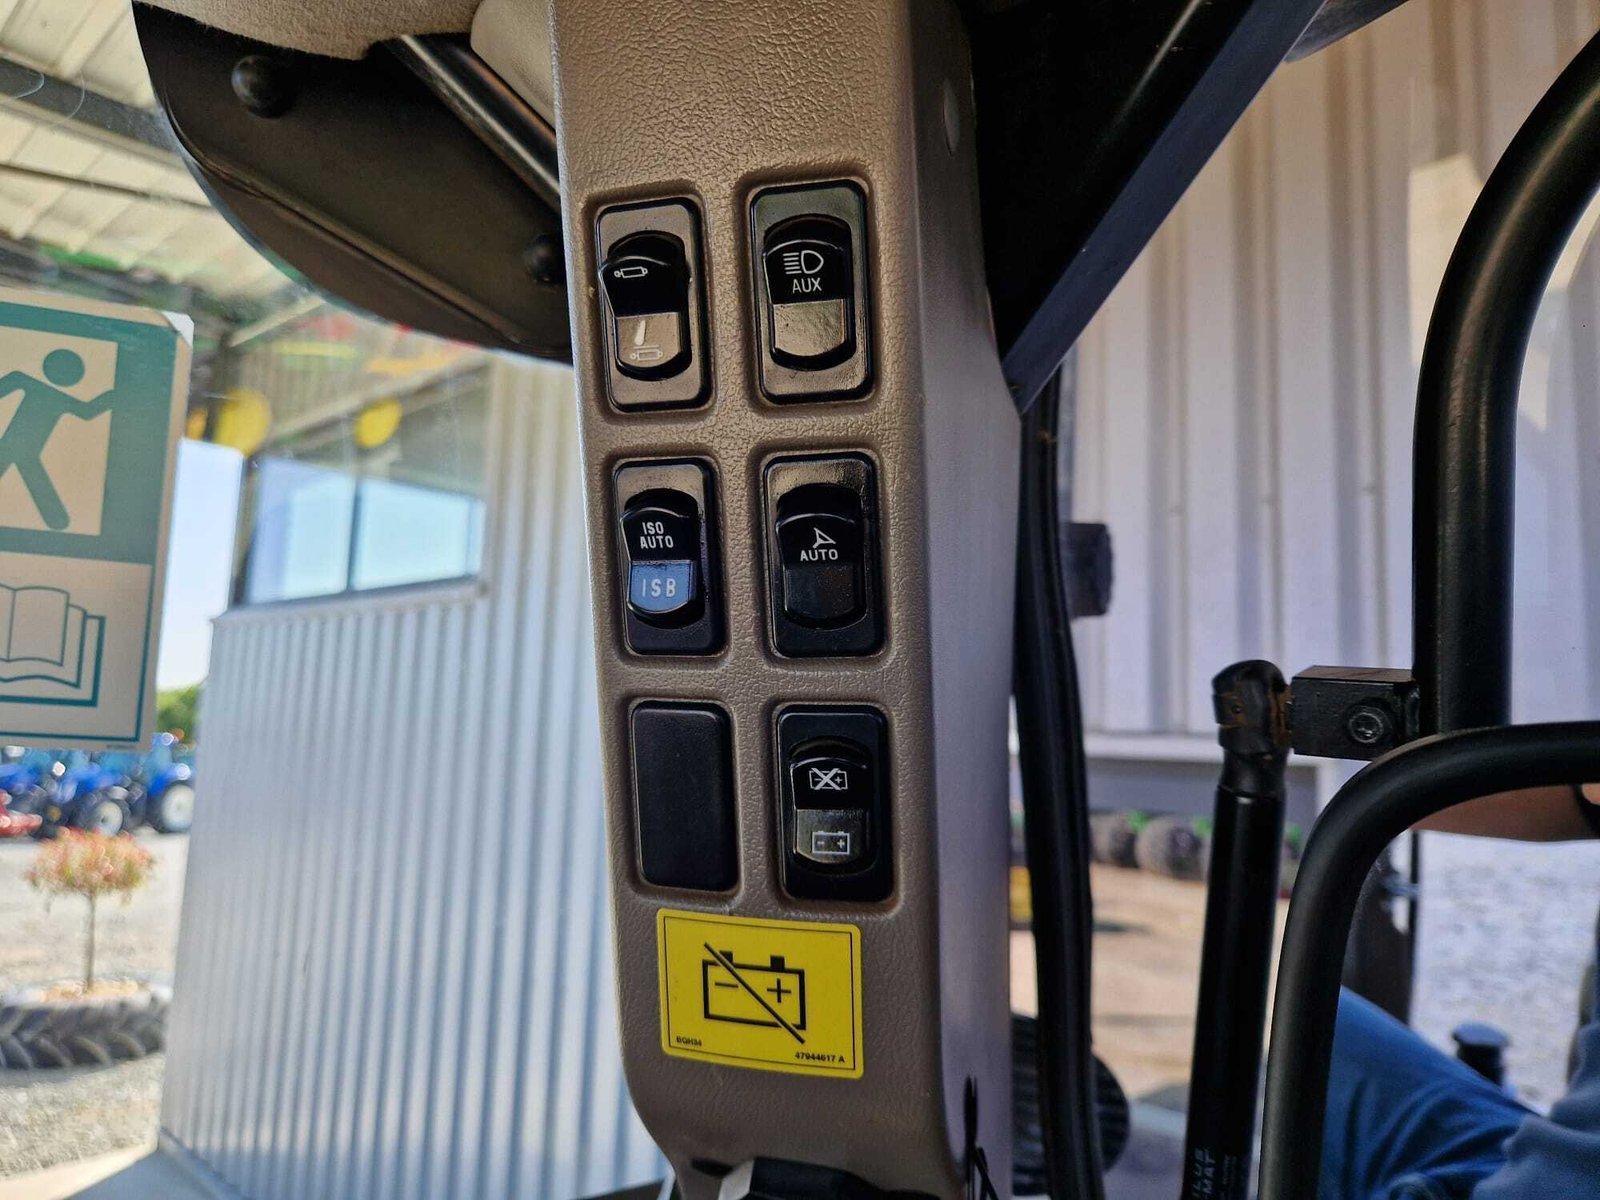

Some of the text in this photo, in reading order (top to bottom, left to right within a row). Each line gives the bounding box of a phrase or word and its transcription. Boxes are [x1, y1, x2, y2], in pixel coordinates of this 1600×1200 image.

[792, 277, 822, 294] AUX
[642, 521, 664, 535] ISO
[640, 535, 674, 549] AUTO
[800, 549, 838, 561] AUTO
[642, 578, 676, 597] ISB
[838, 1055, 845, 1063] A
